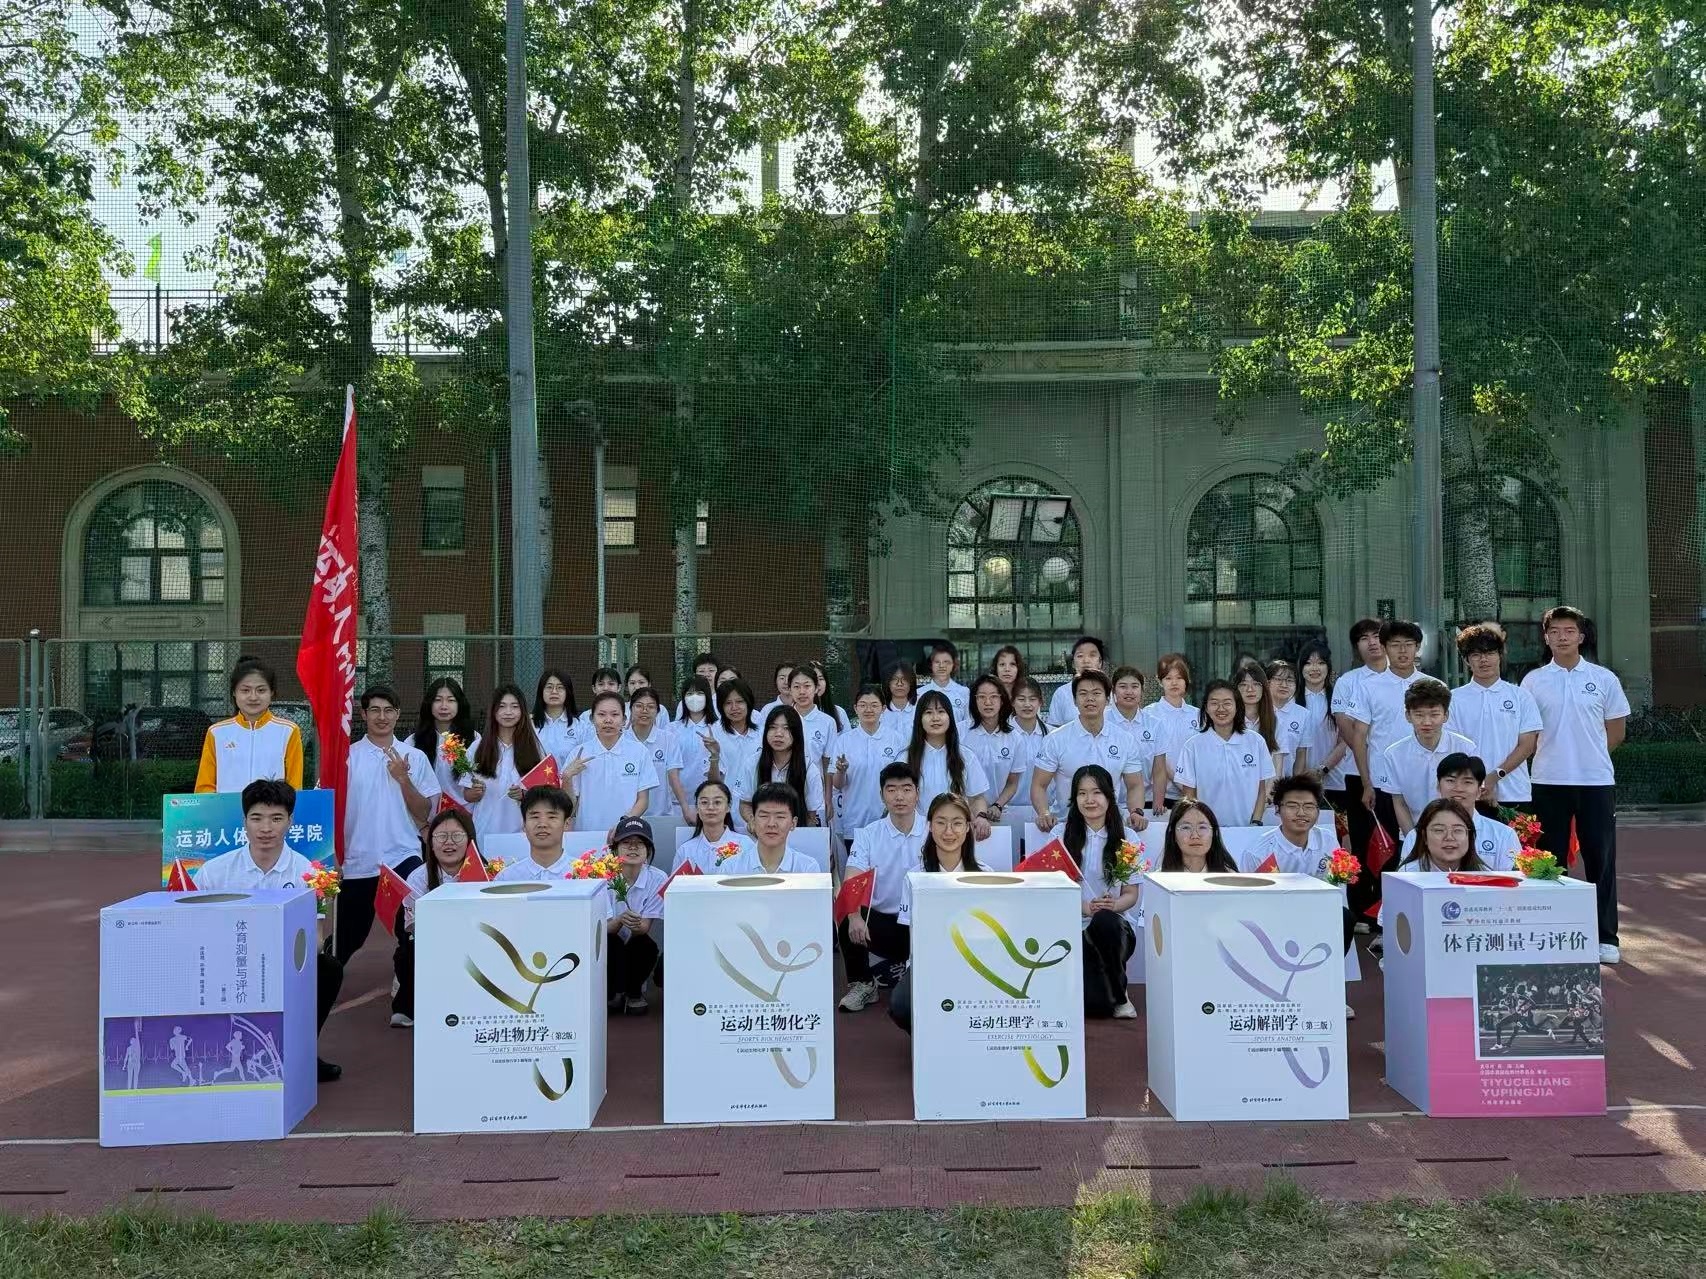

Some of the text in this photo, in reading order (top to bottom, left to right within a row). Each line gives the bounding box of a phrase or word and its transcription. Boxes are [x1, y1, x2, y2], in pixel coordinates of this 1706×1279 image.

[175, 823, 324, 849] 运动人体学院
[1443, 930, 1588, 953] 体育测量与评价
[235, 919, 248, 1004] 体育测量与评价
[720, 1013, 821, 1032] 运动生物化学
[968, 1015, 1035, 1029] 运动生理学
[1229, 1014, 1299, 1031] 运动解剖学
[474, 1026, 549, 1043] 运动生物力学
[1480, 1077, 1571, 1087] TIYUCELIANG
[1481, 1088, 1554, 1097] YUPINGJIA
